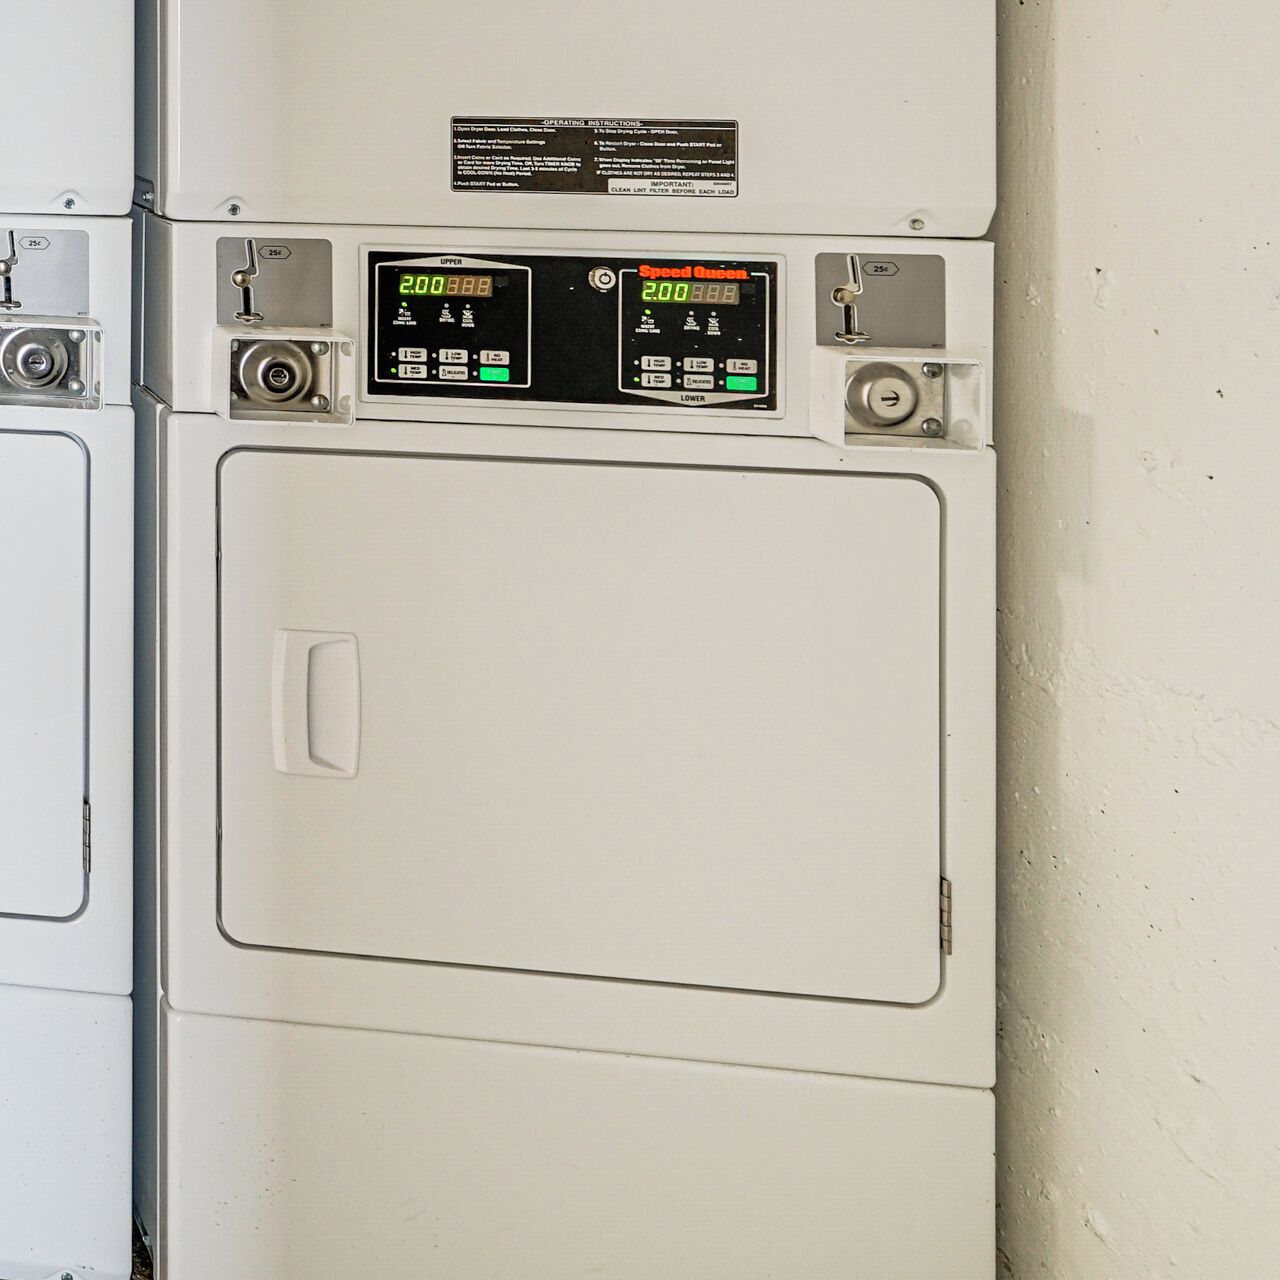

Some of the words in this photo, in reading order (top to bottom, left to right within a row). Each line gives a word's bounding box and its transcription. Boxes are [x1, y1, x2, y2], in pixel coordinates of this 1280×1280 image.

[639, 265, 692, 280] Speed
[694, 266, 747, 280] Queen
[400, 276, 445, 294] 2.00
[642, 282, 688, 301] 2.00
